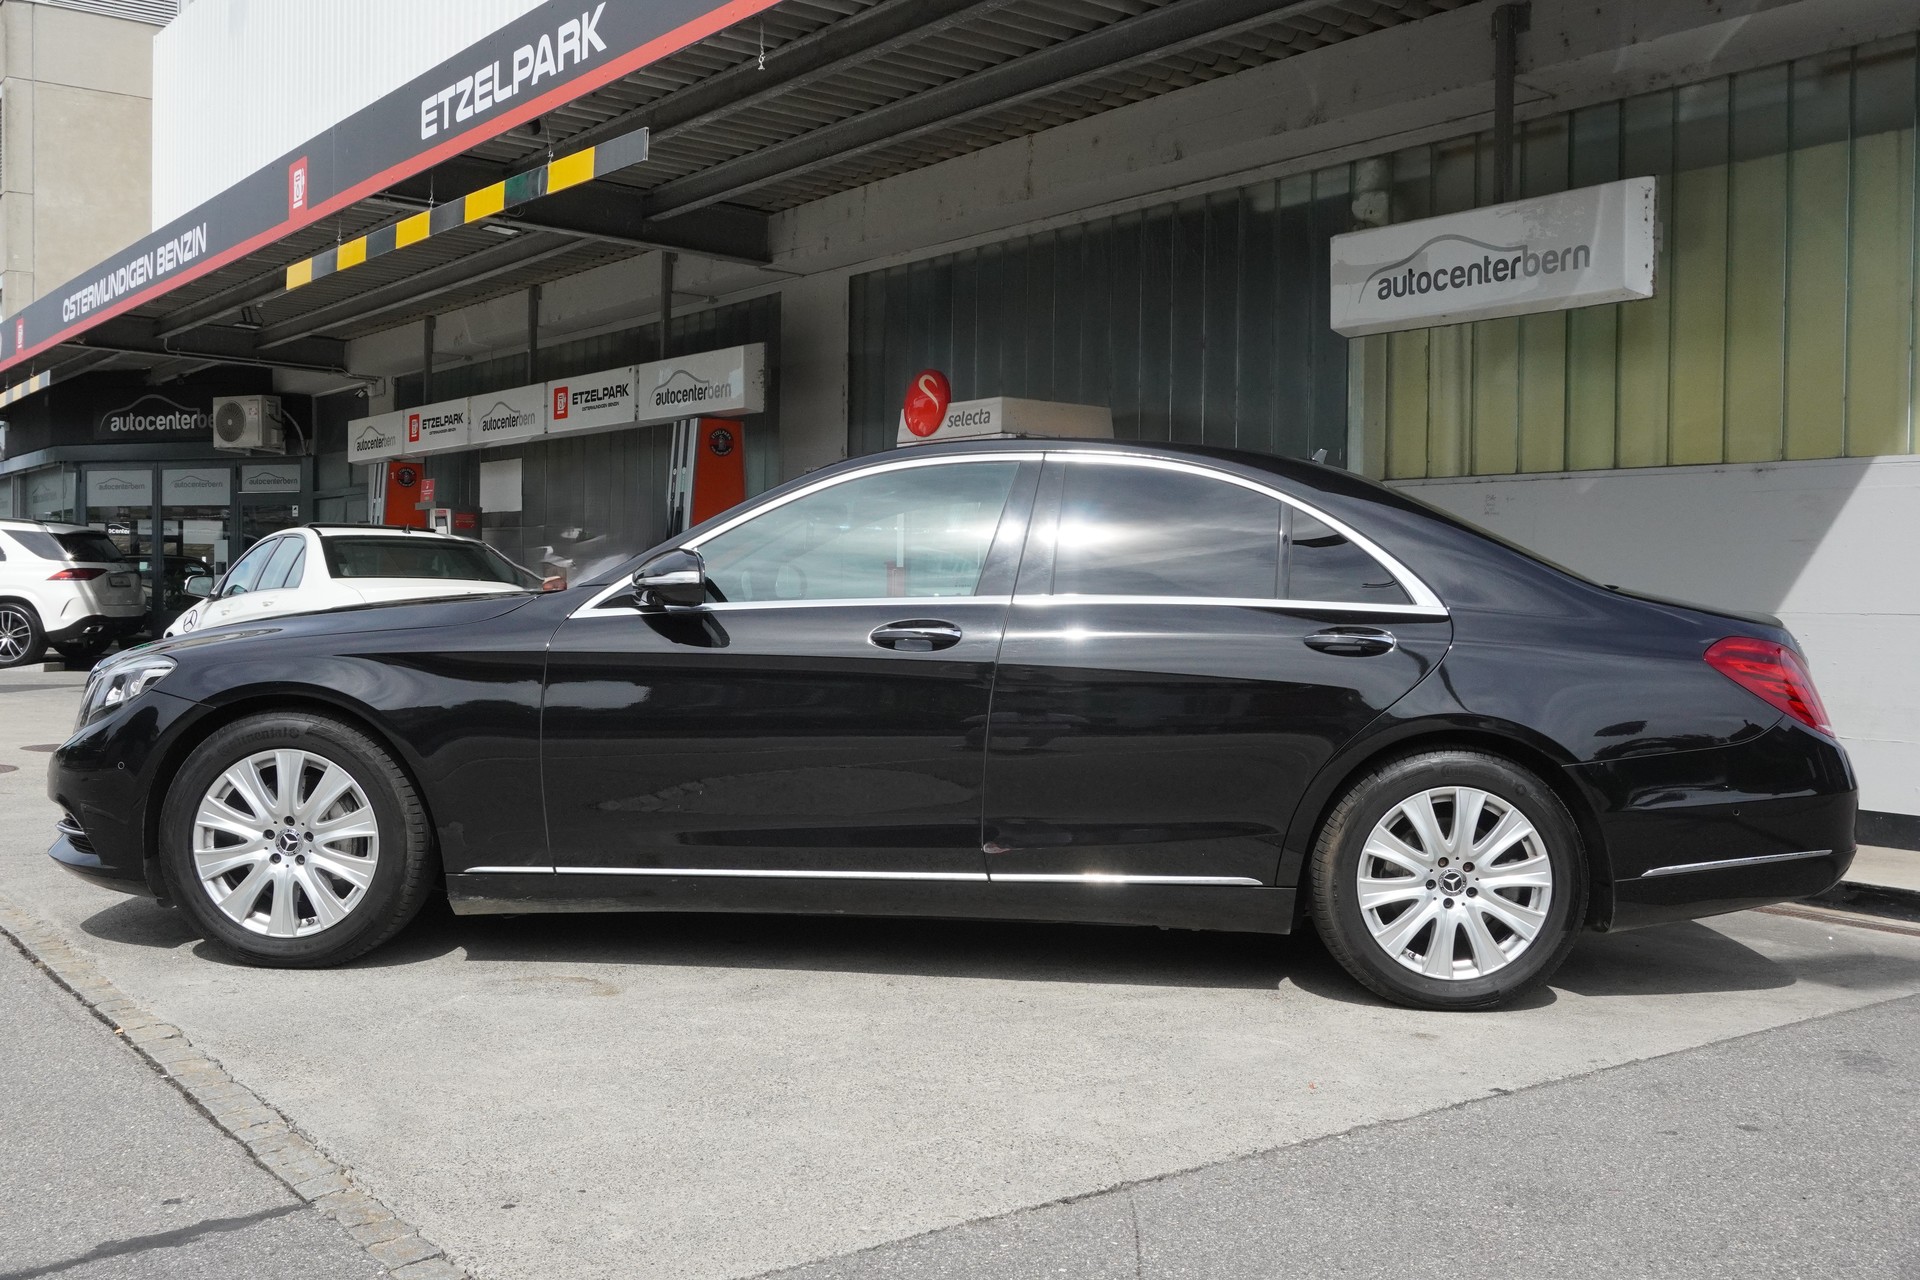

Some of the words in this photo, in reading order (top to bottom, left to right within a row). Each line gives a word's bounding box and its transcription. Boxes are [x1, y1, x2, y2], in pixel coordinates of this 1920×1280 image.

[421, 2, 607, 140] ETZELPARK
[62, 252, 153, 322] OSTERMUNDIGEN
[156, 222, 207, 276] BENZIN
[1377, 244, 1591, 300] autocenterbern
[572, 383, 629, 405] ETZELPARK
[655, 381, 732, 406] autocenterbern
[422, 412, 464, 430] ETZELPARK
[482, 410, 535, 431] autocenterbern
[947, 408, 991, 428] selecta
[356, 434, 396, 452] autocenterbern
[390, 472, 395, 480] 1
